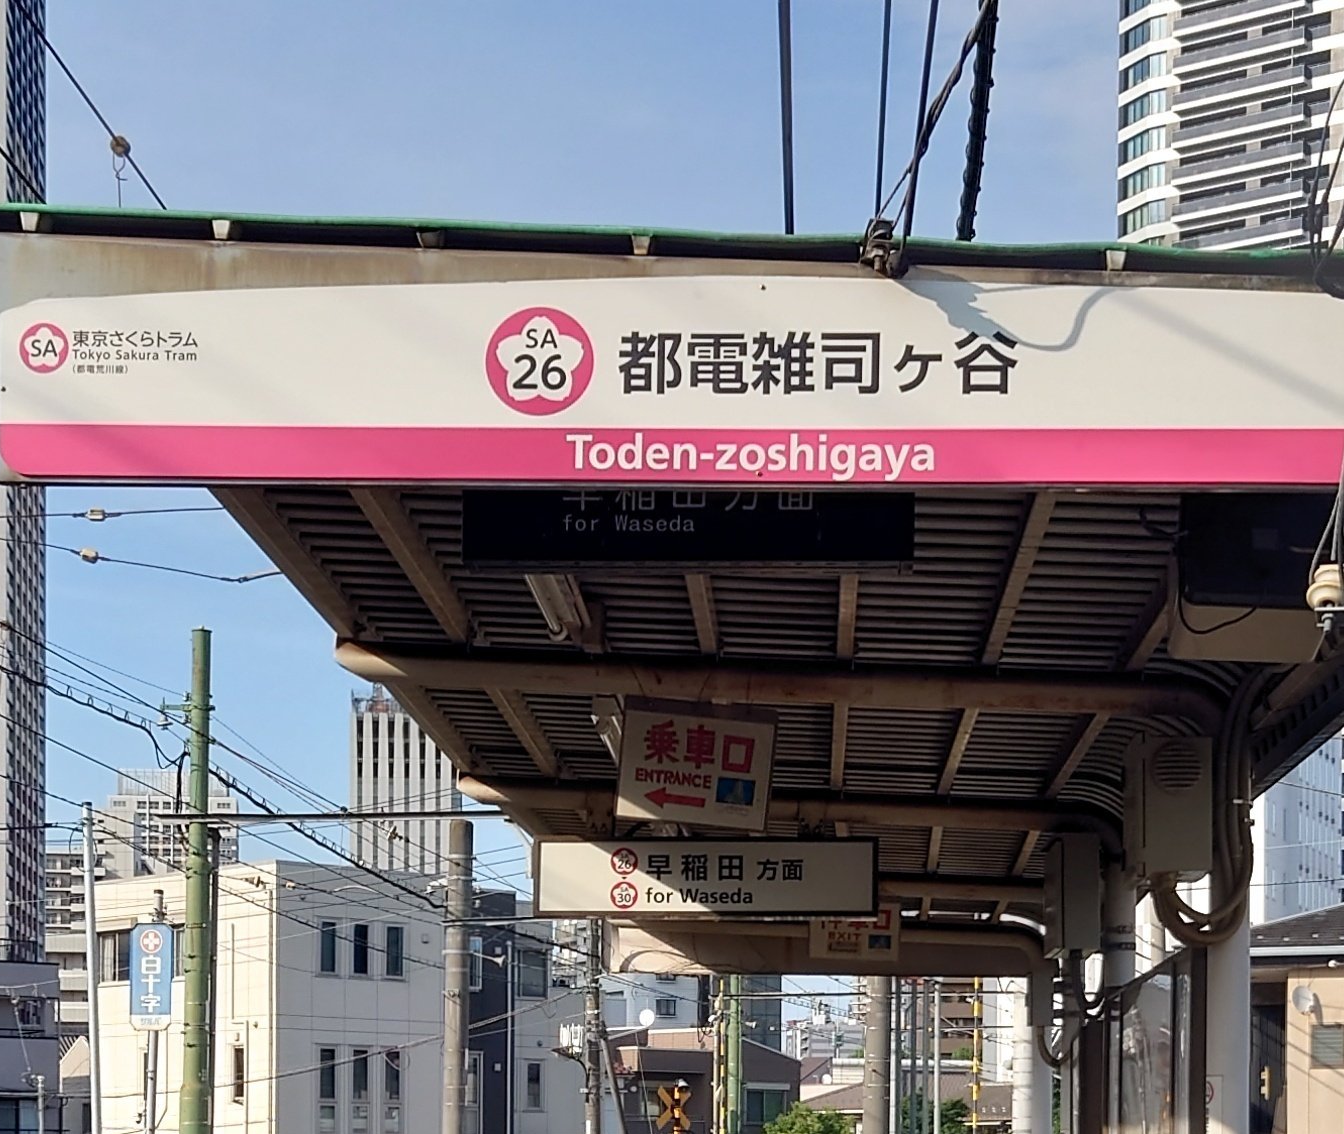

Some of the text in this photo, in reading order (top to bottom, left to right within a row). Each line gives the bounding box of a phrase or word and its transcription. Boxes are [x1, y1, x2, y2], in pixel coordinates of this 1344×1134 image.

[30, 339, 58, 358] SA
[72, 331, 198, 348] 東京さくらトラム
[524, 328, 558, 350] SA
[72, 349, 197, 363] Tokyo Sakura Tram
[618, 331, 1019, 396] 都電雑司ヶ谷
[512, 355, 567, 391] 26
[565, 433, 936, 482] Toden-zoshigaya
[563, 515, 695, 533] for Waseda
[643, 719, 756, 775] 乗車口
[635, 767, 712, 790] ENTRANCE
[617, 859, 632, 870] 26
[617, 893, 632, 903] 30
[645, 888, 753, 905] for Waseda
[140, 955, 162, 1013] 白十字
